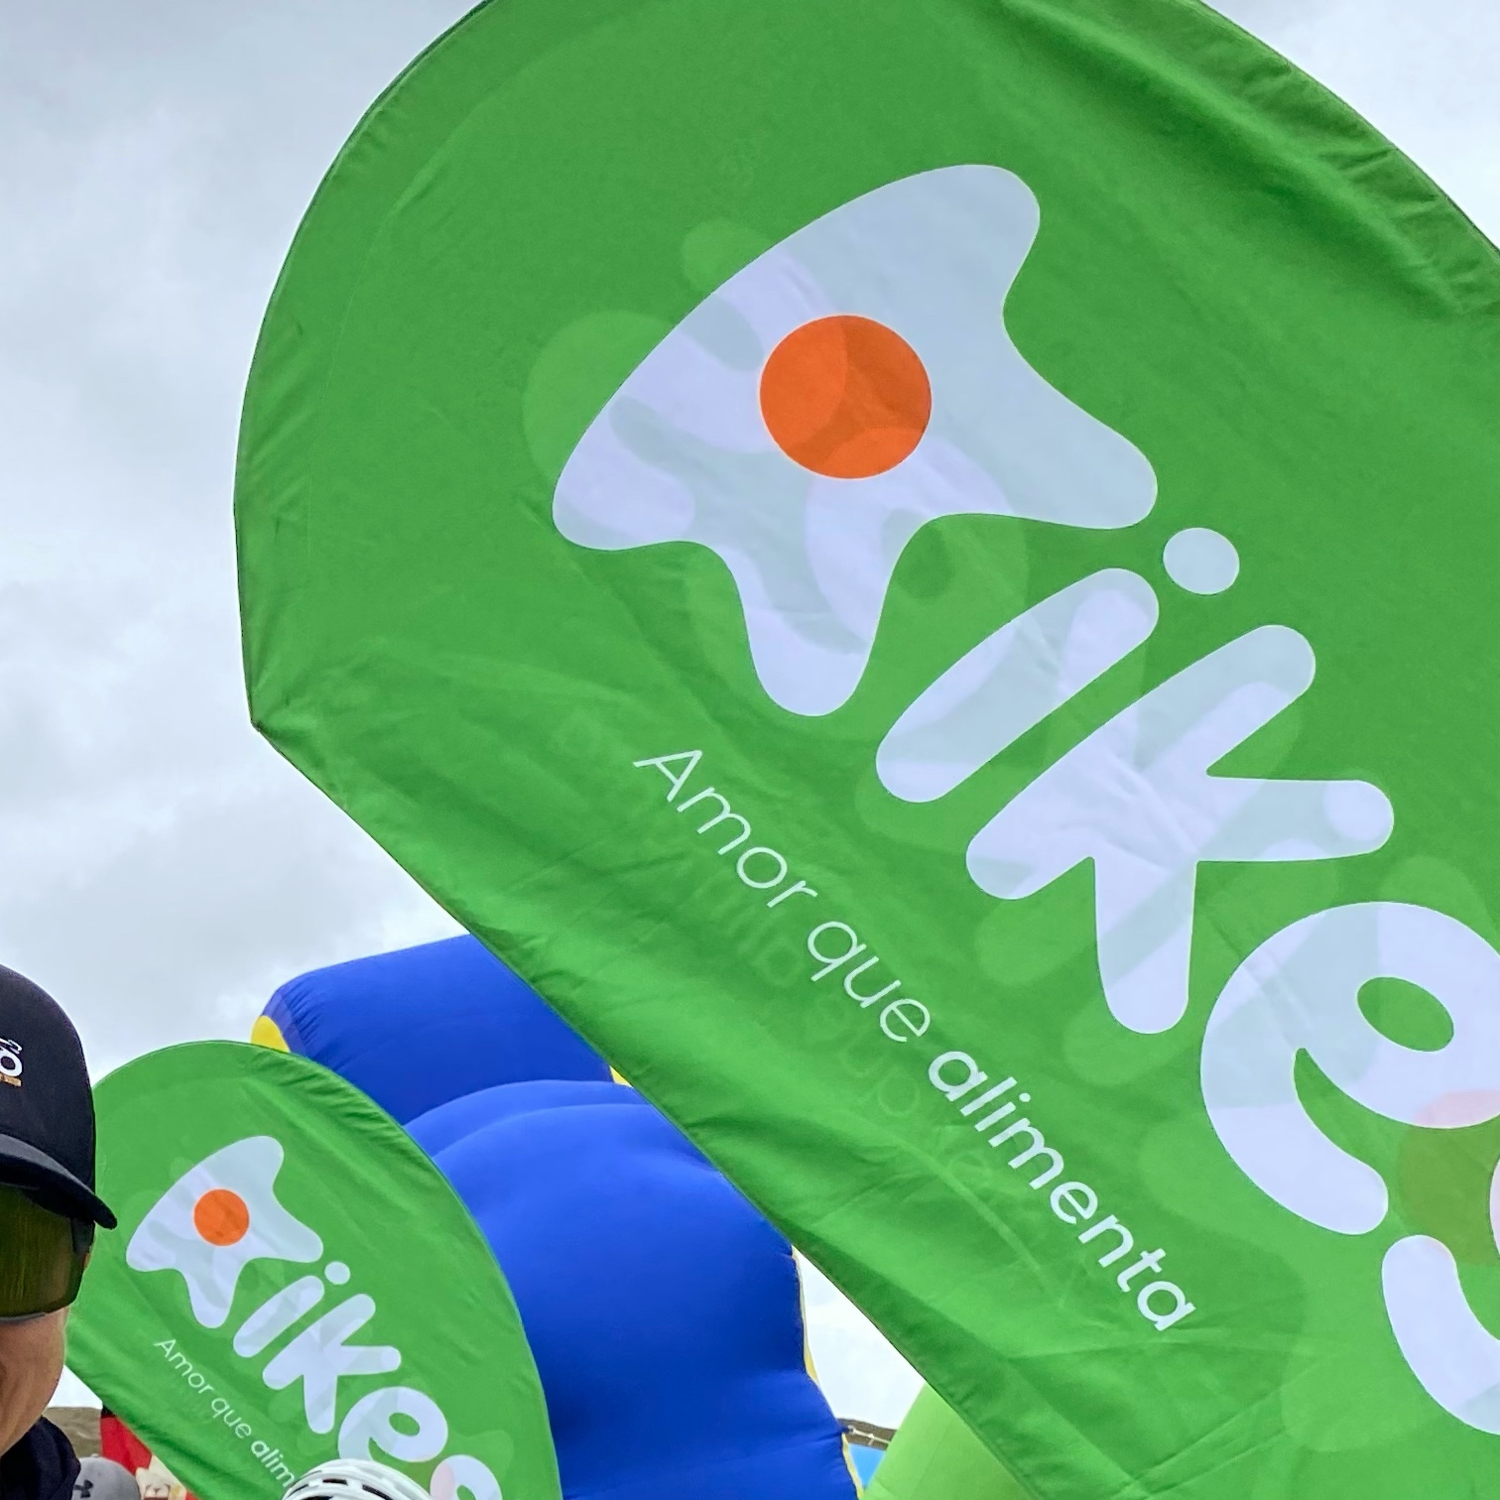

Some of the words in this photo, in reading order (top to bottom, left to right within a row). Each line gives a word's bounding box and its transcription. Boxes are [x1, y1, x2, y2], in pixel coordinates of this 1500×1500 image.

[633, 747, 819, 910] Amor
[807, 918, 930, 1043] que
[927, 1048, 1196, 1331] alimenta
[153, 1338, 215, 1394] Amor
[211, 1397, 252, 1439] que
